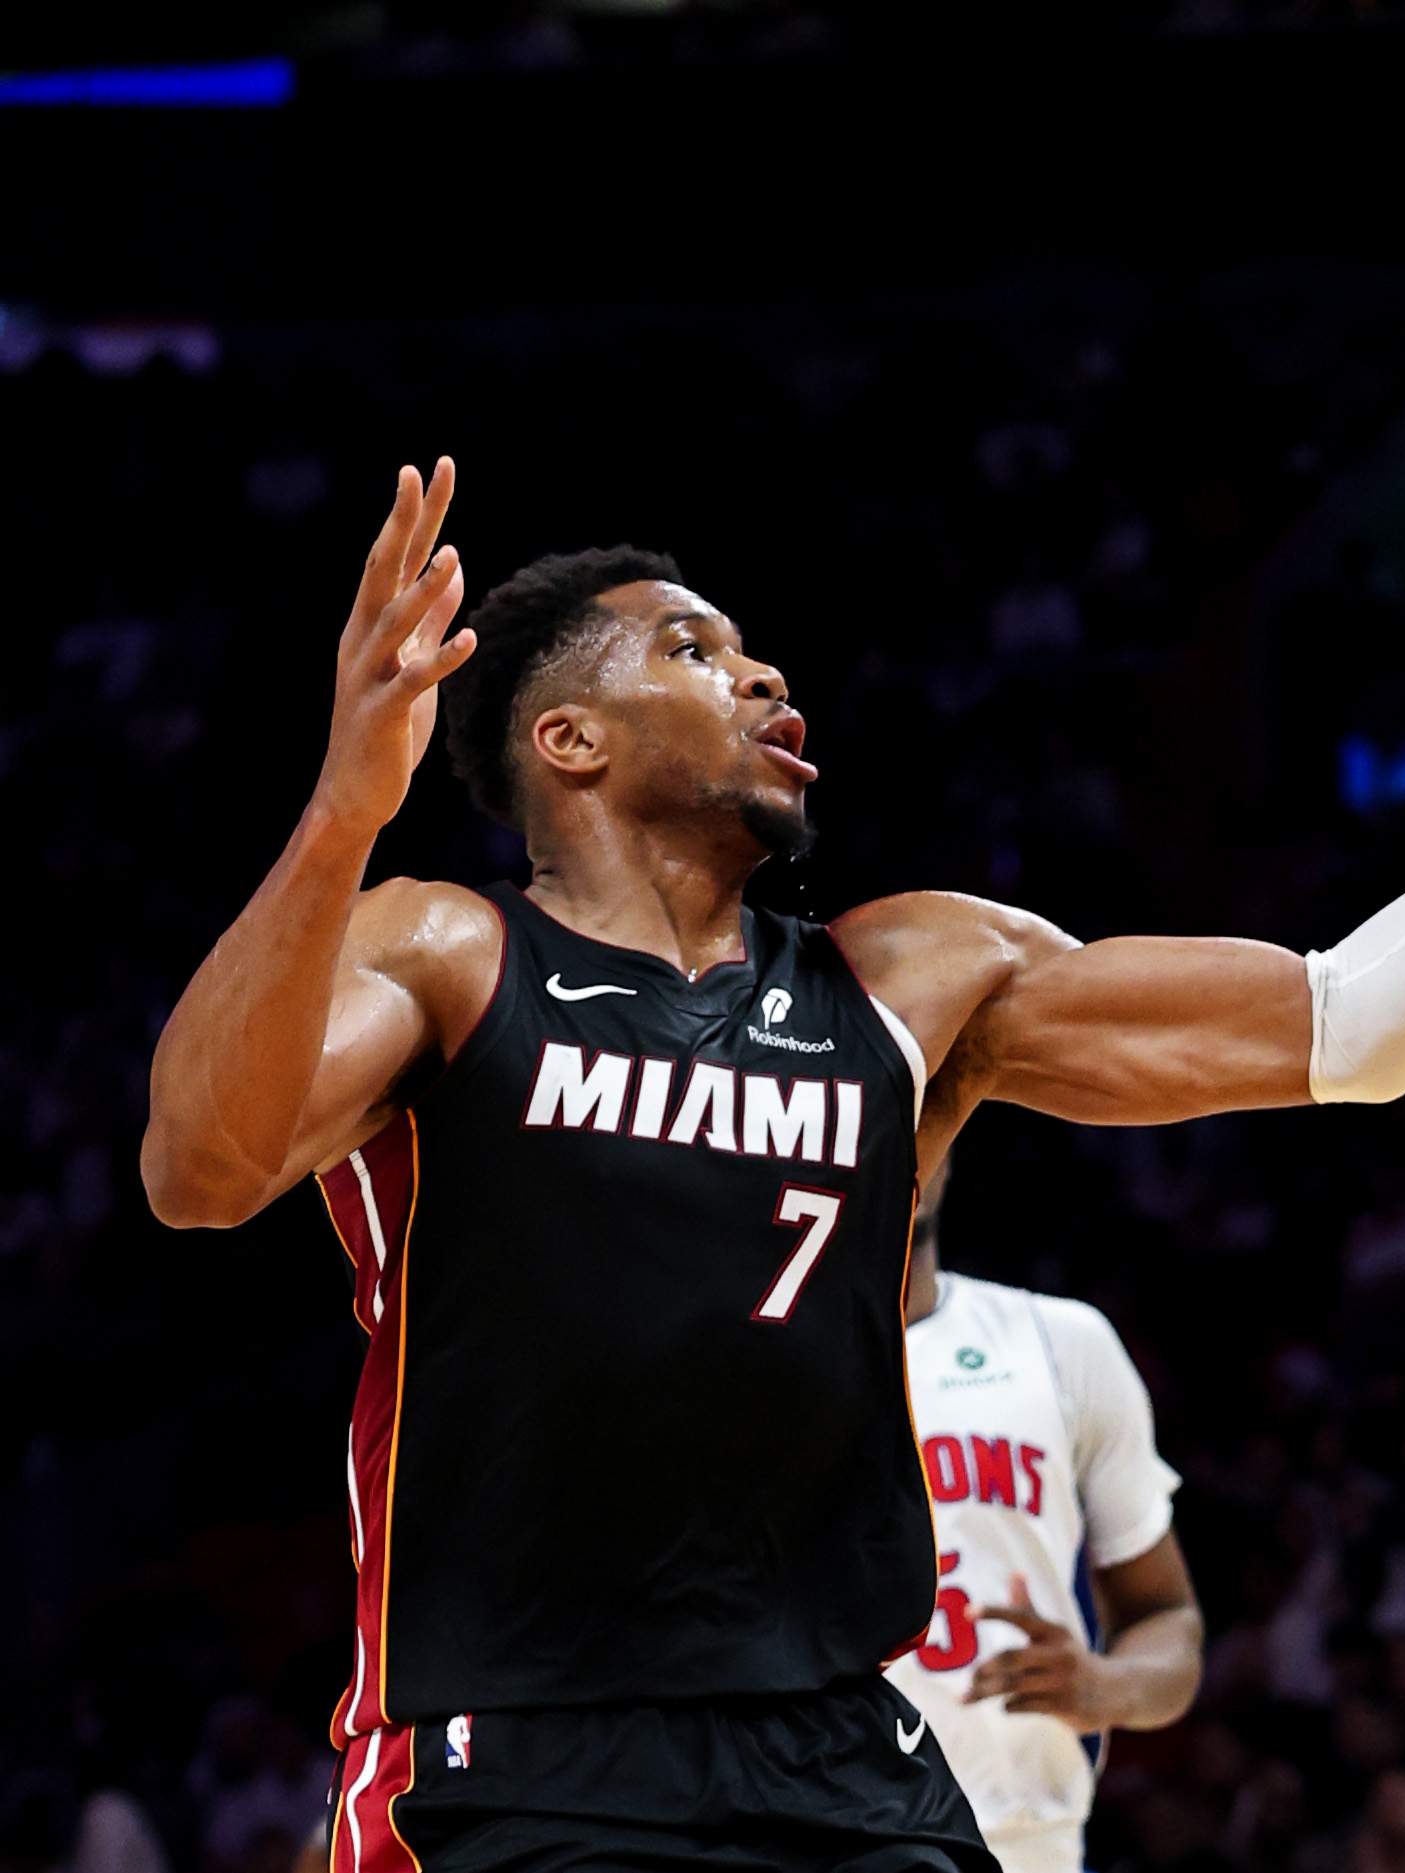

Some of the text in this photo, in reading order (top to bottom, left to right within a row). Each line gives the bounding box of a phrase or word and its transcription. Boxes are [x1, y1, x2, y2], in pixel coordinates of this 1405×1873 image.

[520, 1039, 864, 1169] MIAMI
[747, 1025, 835, 1053] Robinhood
[751, 1180, 846, 1325] 7
